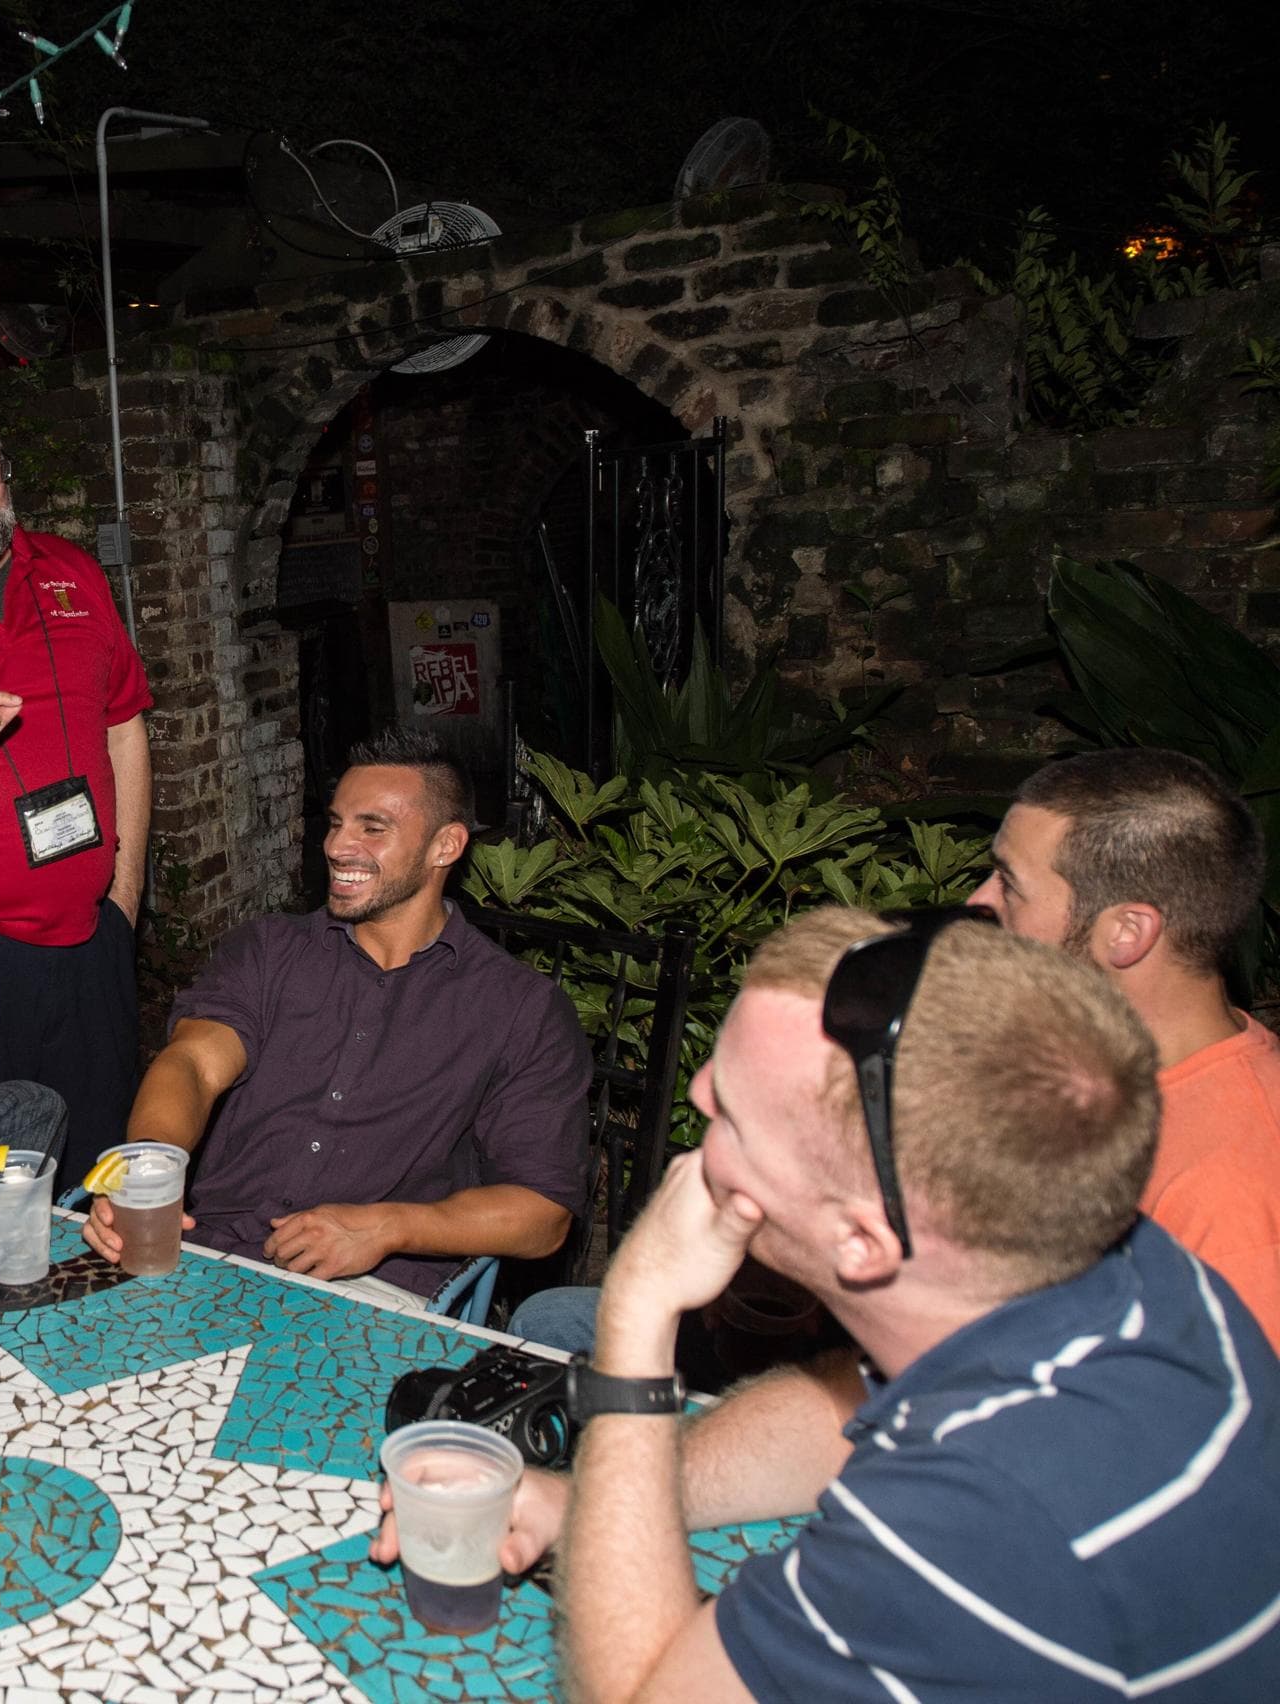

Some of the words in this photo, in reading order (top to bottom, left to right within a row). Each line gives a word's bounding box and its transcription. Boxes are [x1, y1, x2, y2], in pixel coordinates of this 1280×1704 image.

[473, 613, 488, 626] 420
[413, 655, 479, 681] REBEL
[431, 672, 475, 704] IPA
